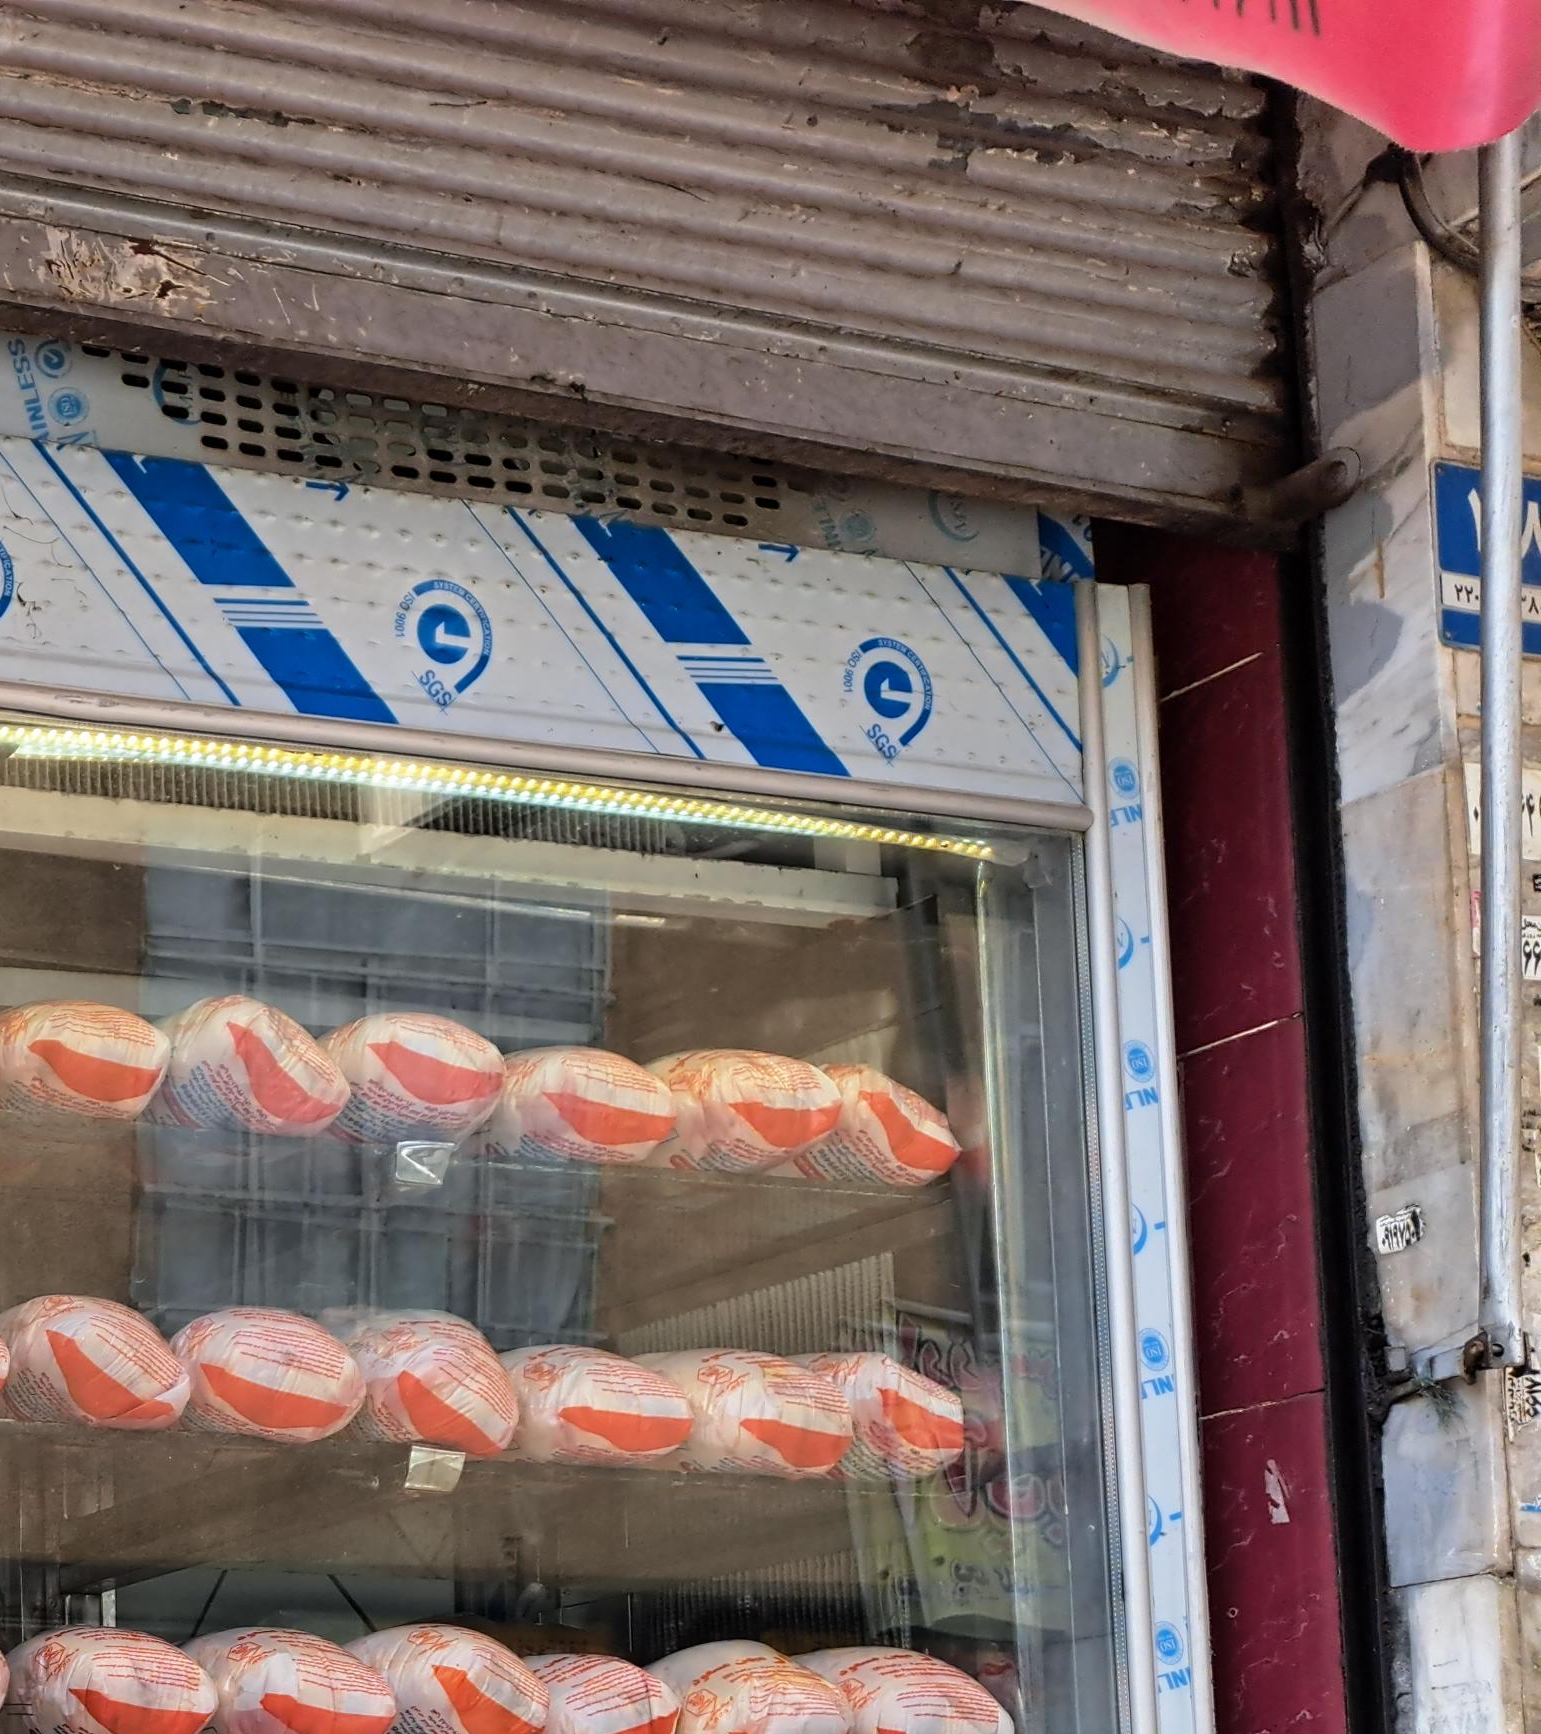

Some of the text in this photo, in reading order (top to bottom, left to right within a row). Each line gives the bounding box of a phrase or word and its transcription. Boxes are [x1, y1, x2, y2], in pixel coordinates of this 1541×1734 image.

[433, 582, 465, 598] SYSTEM
[394, 591, 416, 638] ISO 9001
[878, 639, 907, 653] SYSTEM
[420, 670, 452, 706] SGS
[843, 650, 862, 693] ISO 9001
[867, 724, 897, 759] SGS
